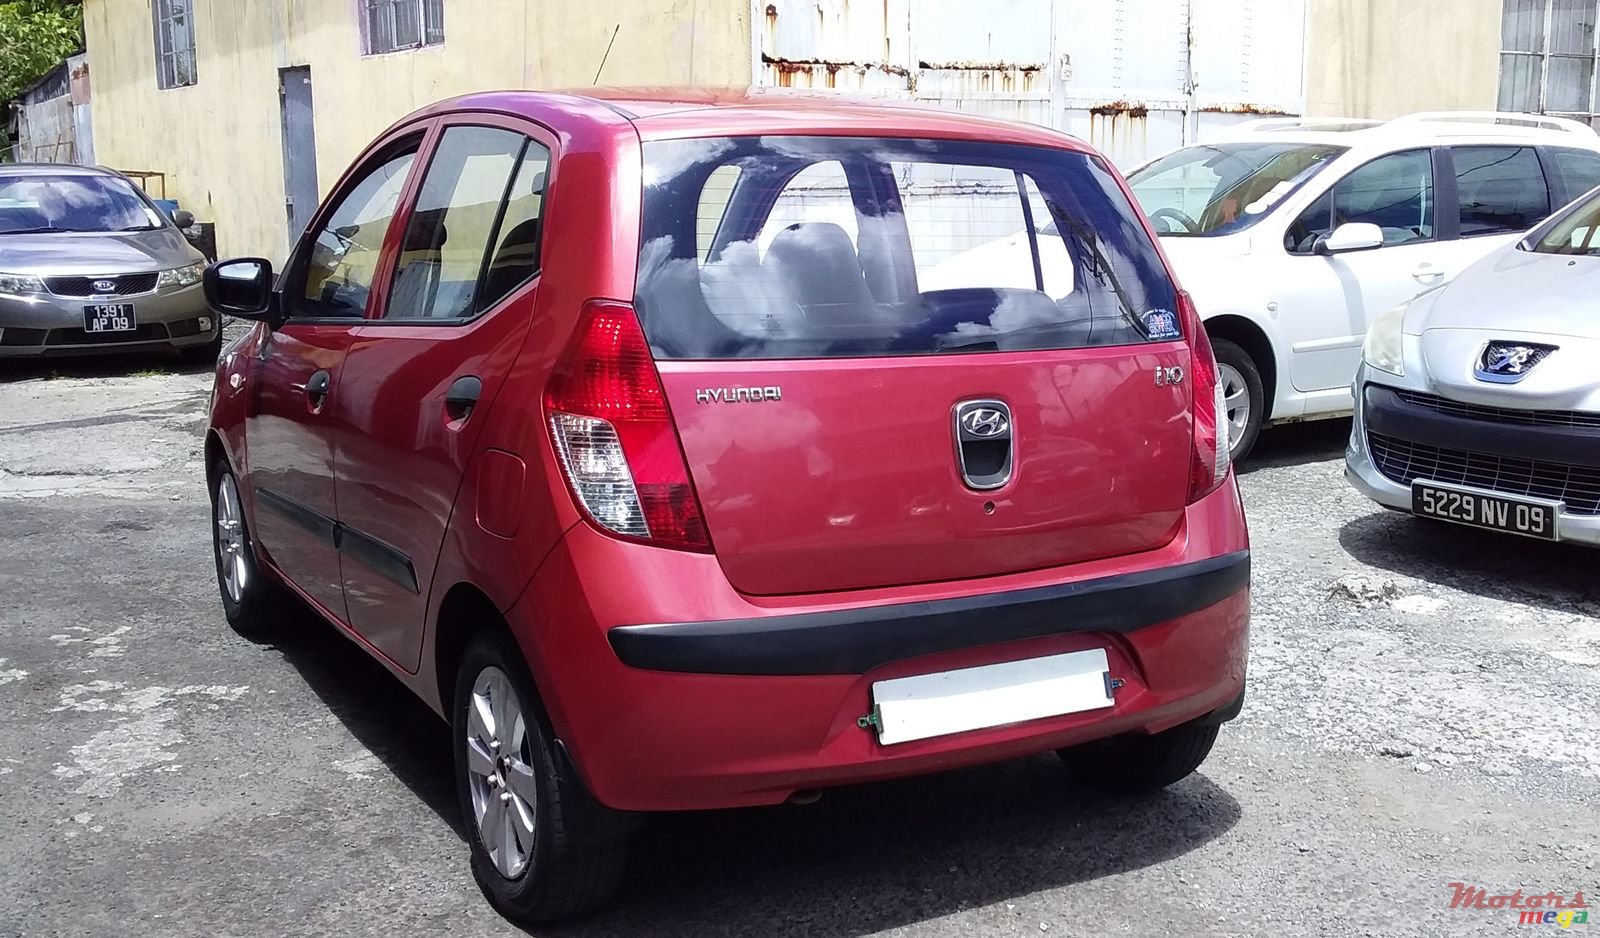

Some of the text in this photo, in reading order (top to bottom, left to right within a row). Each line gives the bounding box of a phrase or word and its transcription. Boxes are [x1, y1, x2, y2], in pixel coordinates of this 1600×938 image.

[94, 305, 124, 317] 1391
[93, 317, 129, 330] AP 09
[696, 386, 782, 404] HYUNDAI
[1423, 491, 1544, 533] 5229 NV 09
